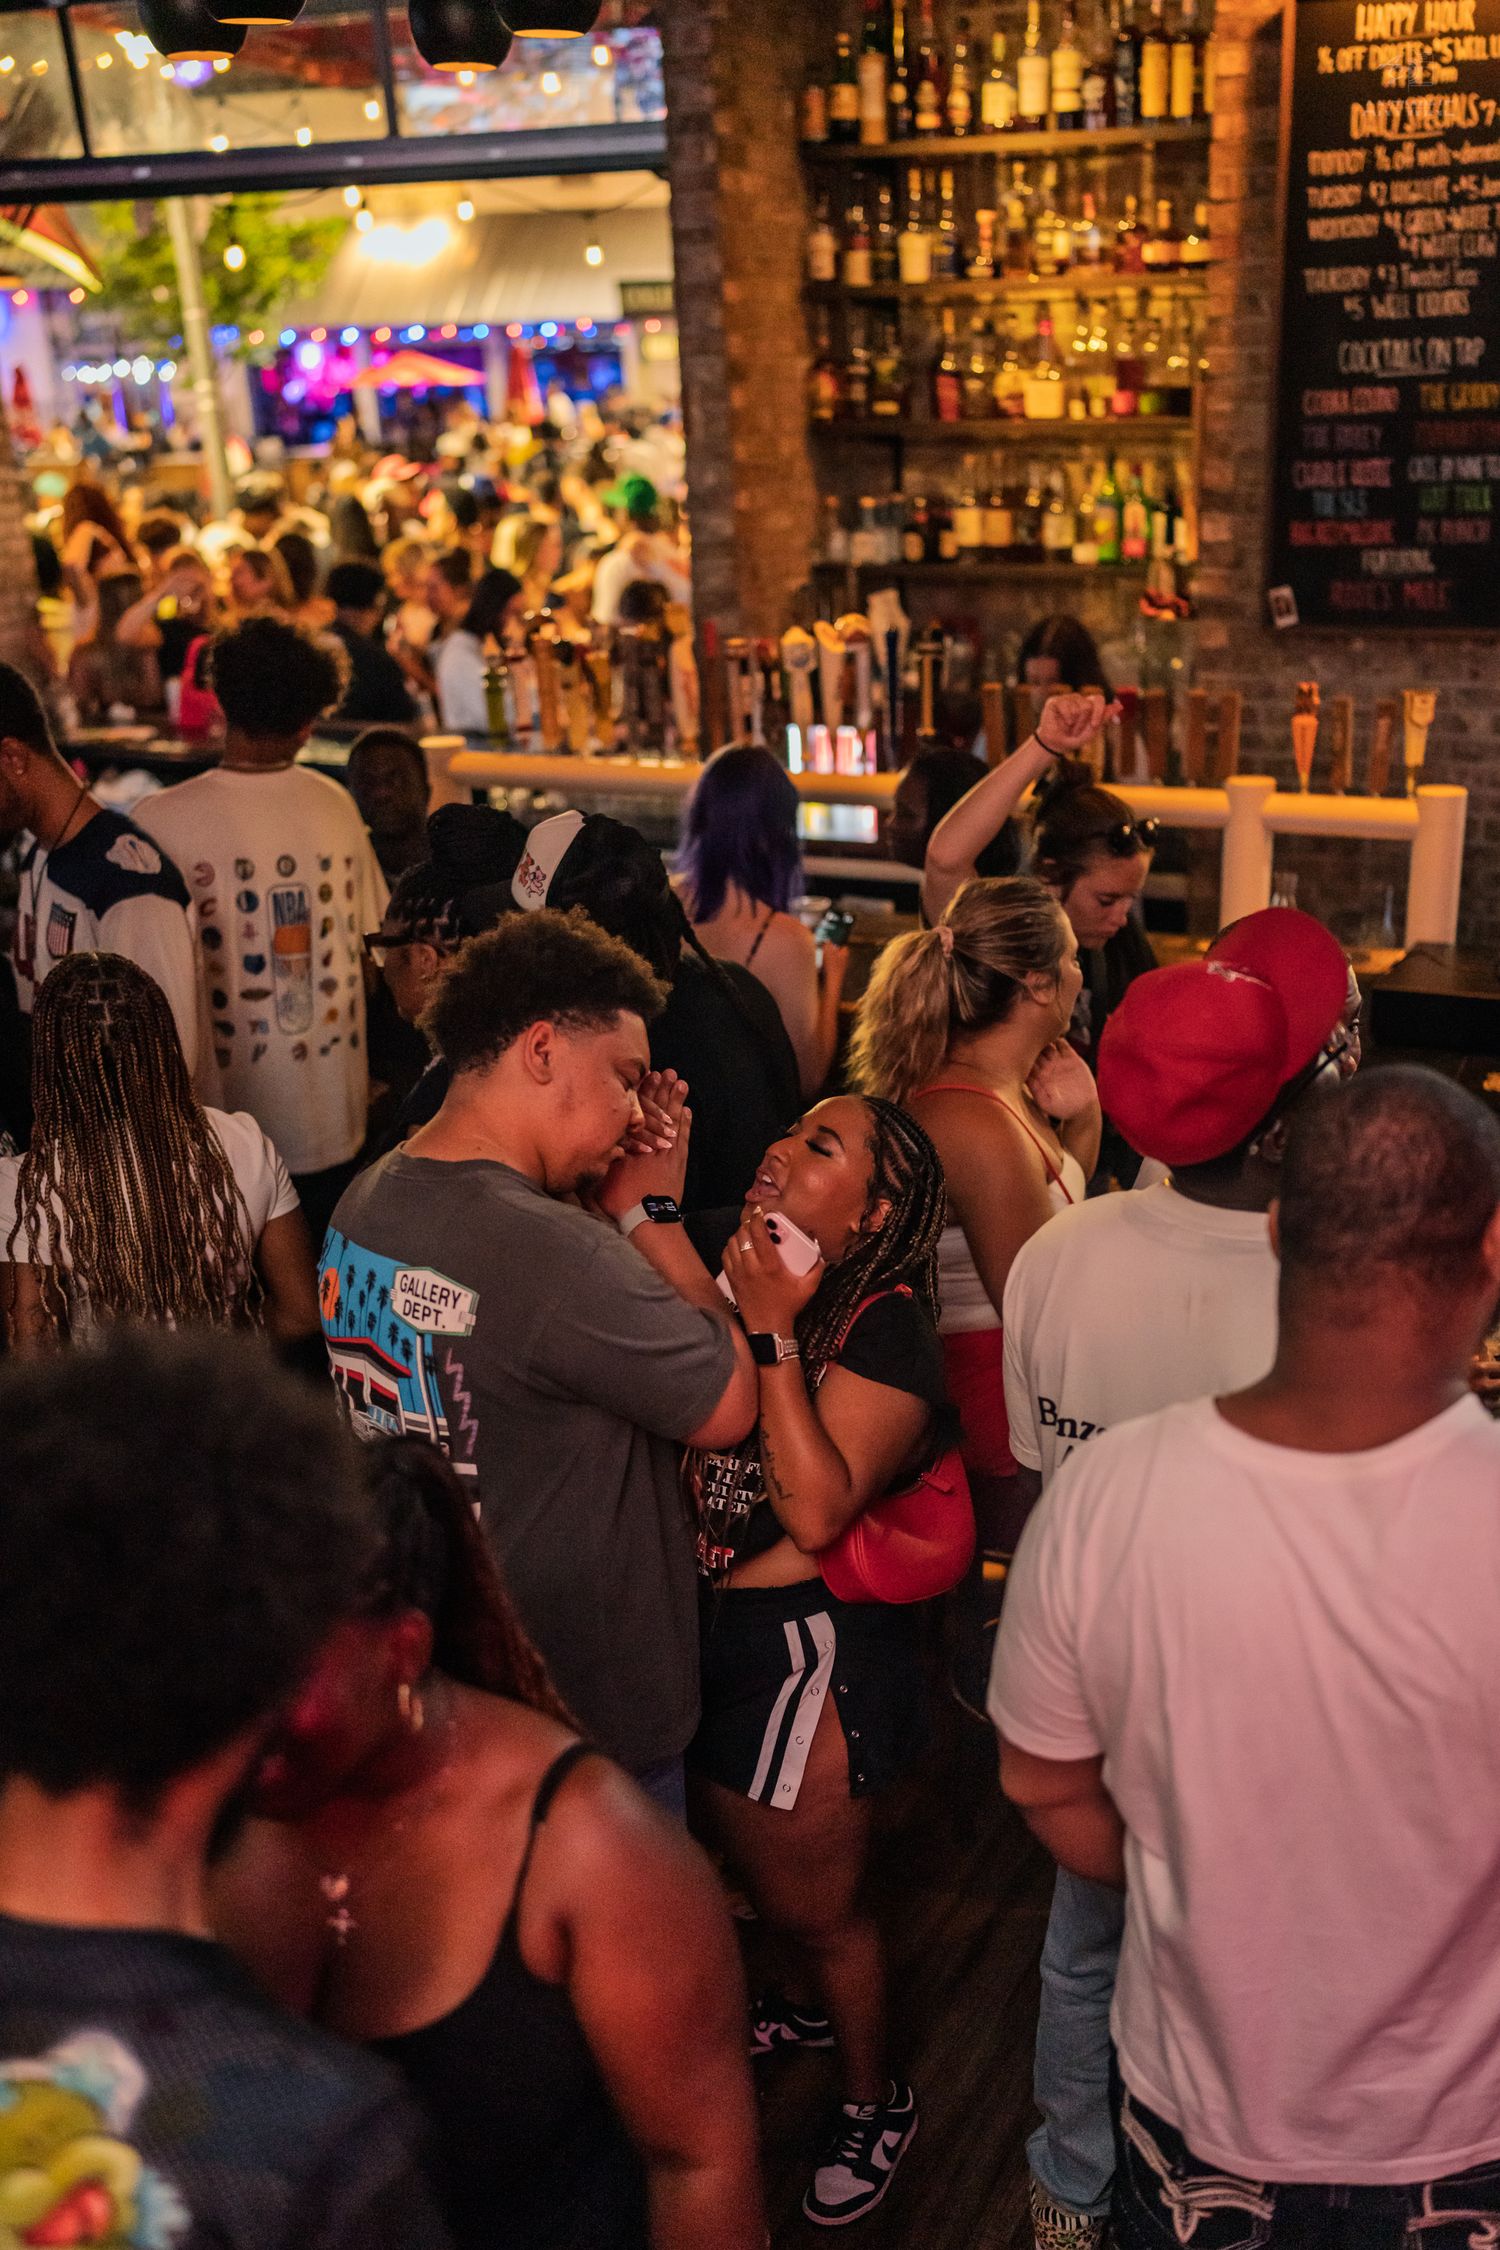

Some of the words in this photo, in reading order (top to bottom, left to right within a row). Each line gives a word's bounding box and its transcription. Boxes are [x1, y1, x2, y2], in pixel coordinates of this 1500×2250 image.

[1355, 3, 1418, 41] HAPPY
[1424, 0, 1476, 32] HOUR
[1350, 100, 1404, 139] DAILY
[1403, 92, 1480, 133] SPECIALS
[273, 891, 309, 924] NBA
[400, 1273, 463, 1310] GALLERY
[403, 1299, 446, 1329] DEPT.
